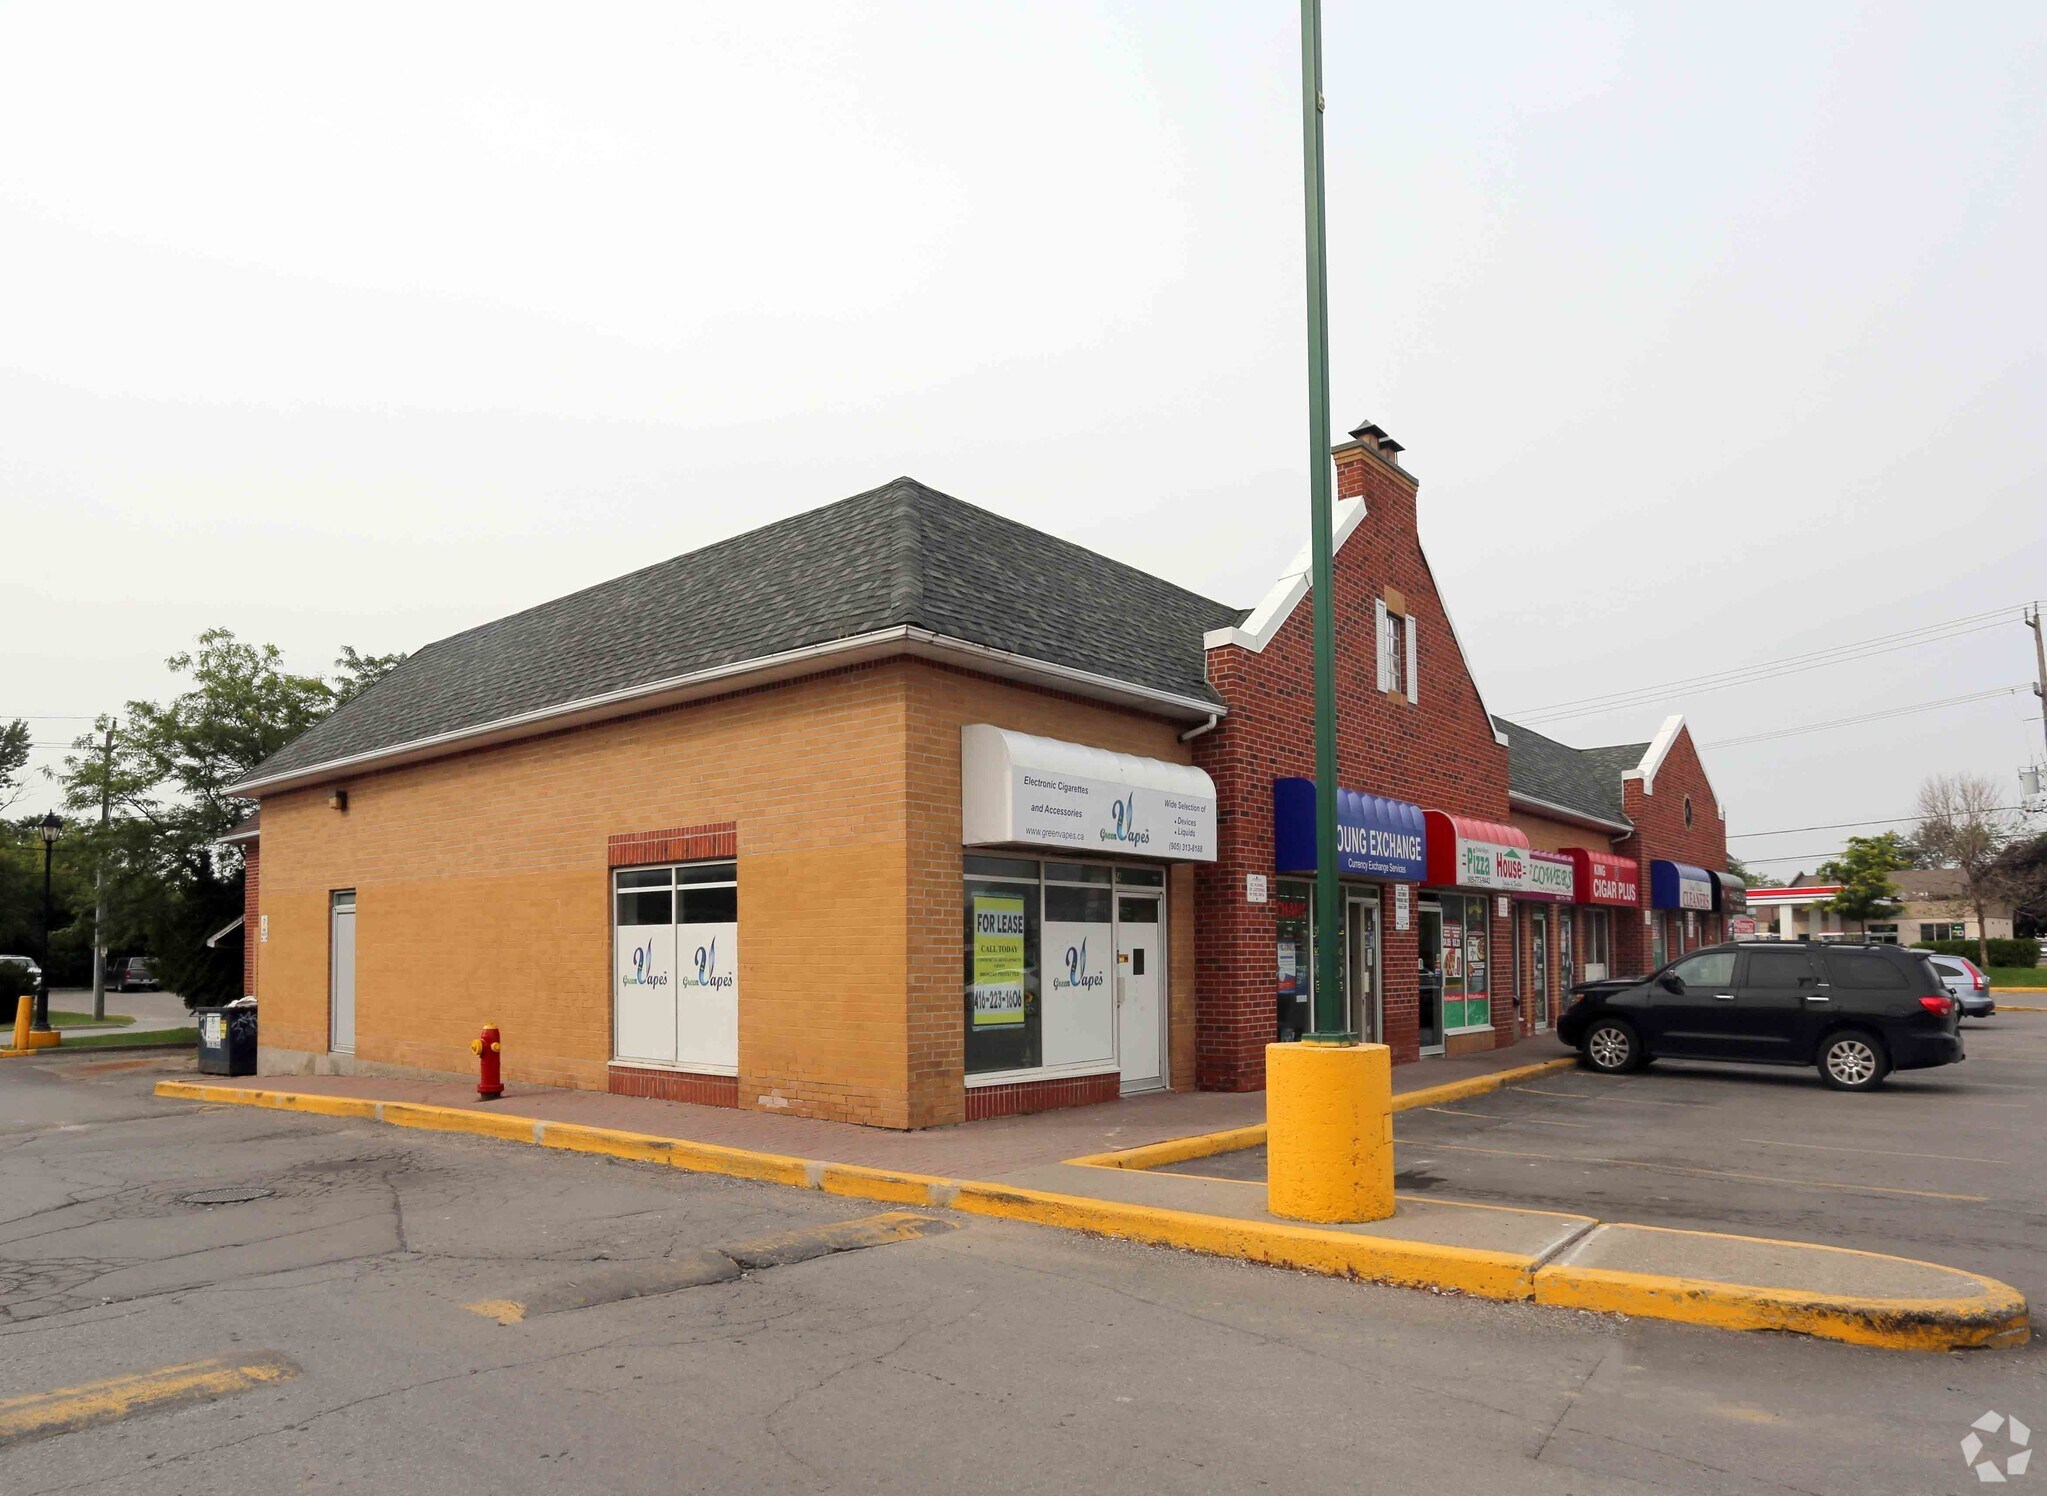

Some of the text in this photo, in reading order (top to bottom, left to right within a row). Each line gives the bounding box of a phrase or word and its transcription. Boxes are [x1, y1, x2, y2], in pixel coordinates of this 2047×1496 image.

[1024, 775, 1089, 795] Electronic Cigarettes
[1030, 804, 1083, 818] and Accessories
[1164, 799, 1207, 813] Wide Selection of
[1177, 816, 1197, 827] Devices
[1025, 827, 1085, 841] www.greenvapes.ca
[1100, 827, 1117, 842] Green
[1177, 828, 1196, 837] Liquids
[1336, 824, 1422, 861] OUNG EXCHANGE
[1347, 857, 1407, 874] Currency Exchange Services
[1467, 847, 1522, 879] Pizza House
[1529, 862, 1573, 890] LOWERS
[1593, 878, 1636, 901] CIGAR PLUS
[977, 913, 1023, 934] FOR LEASE
[980, 944, 1019, 954] CALL TODAY
[622, 974, 638, 987] Green
[682, 976, 699, 989] Green
[1053, 977, 1071, 991] Green
[974, 989, 1022, 1010] 416-223-1606
